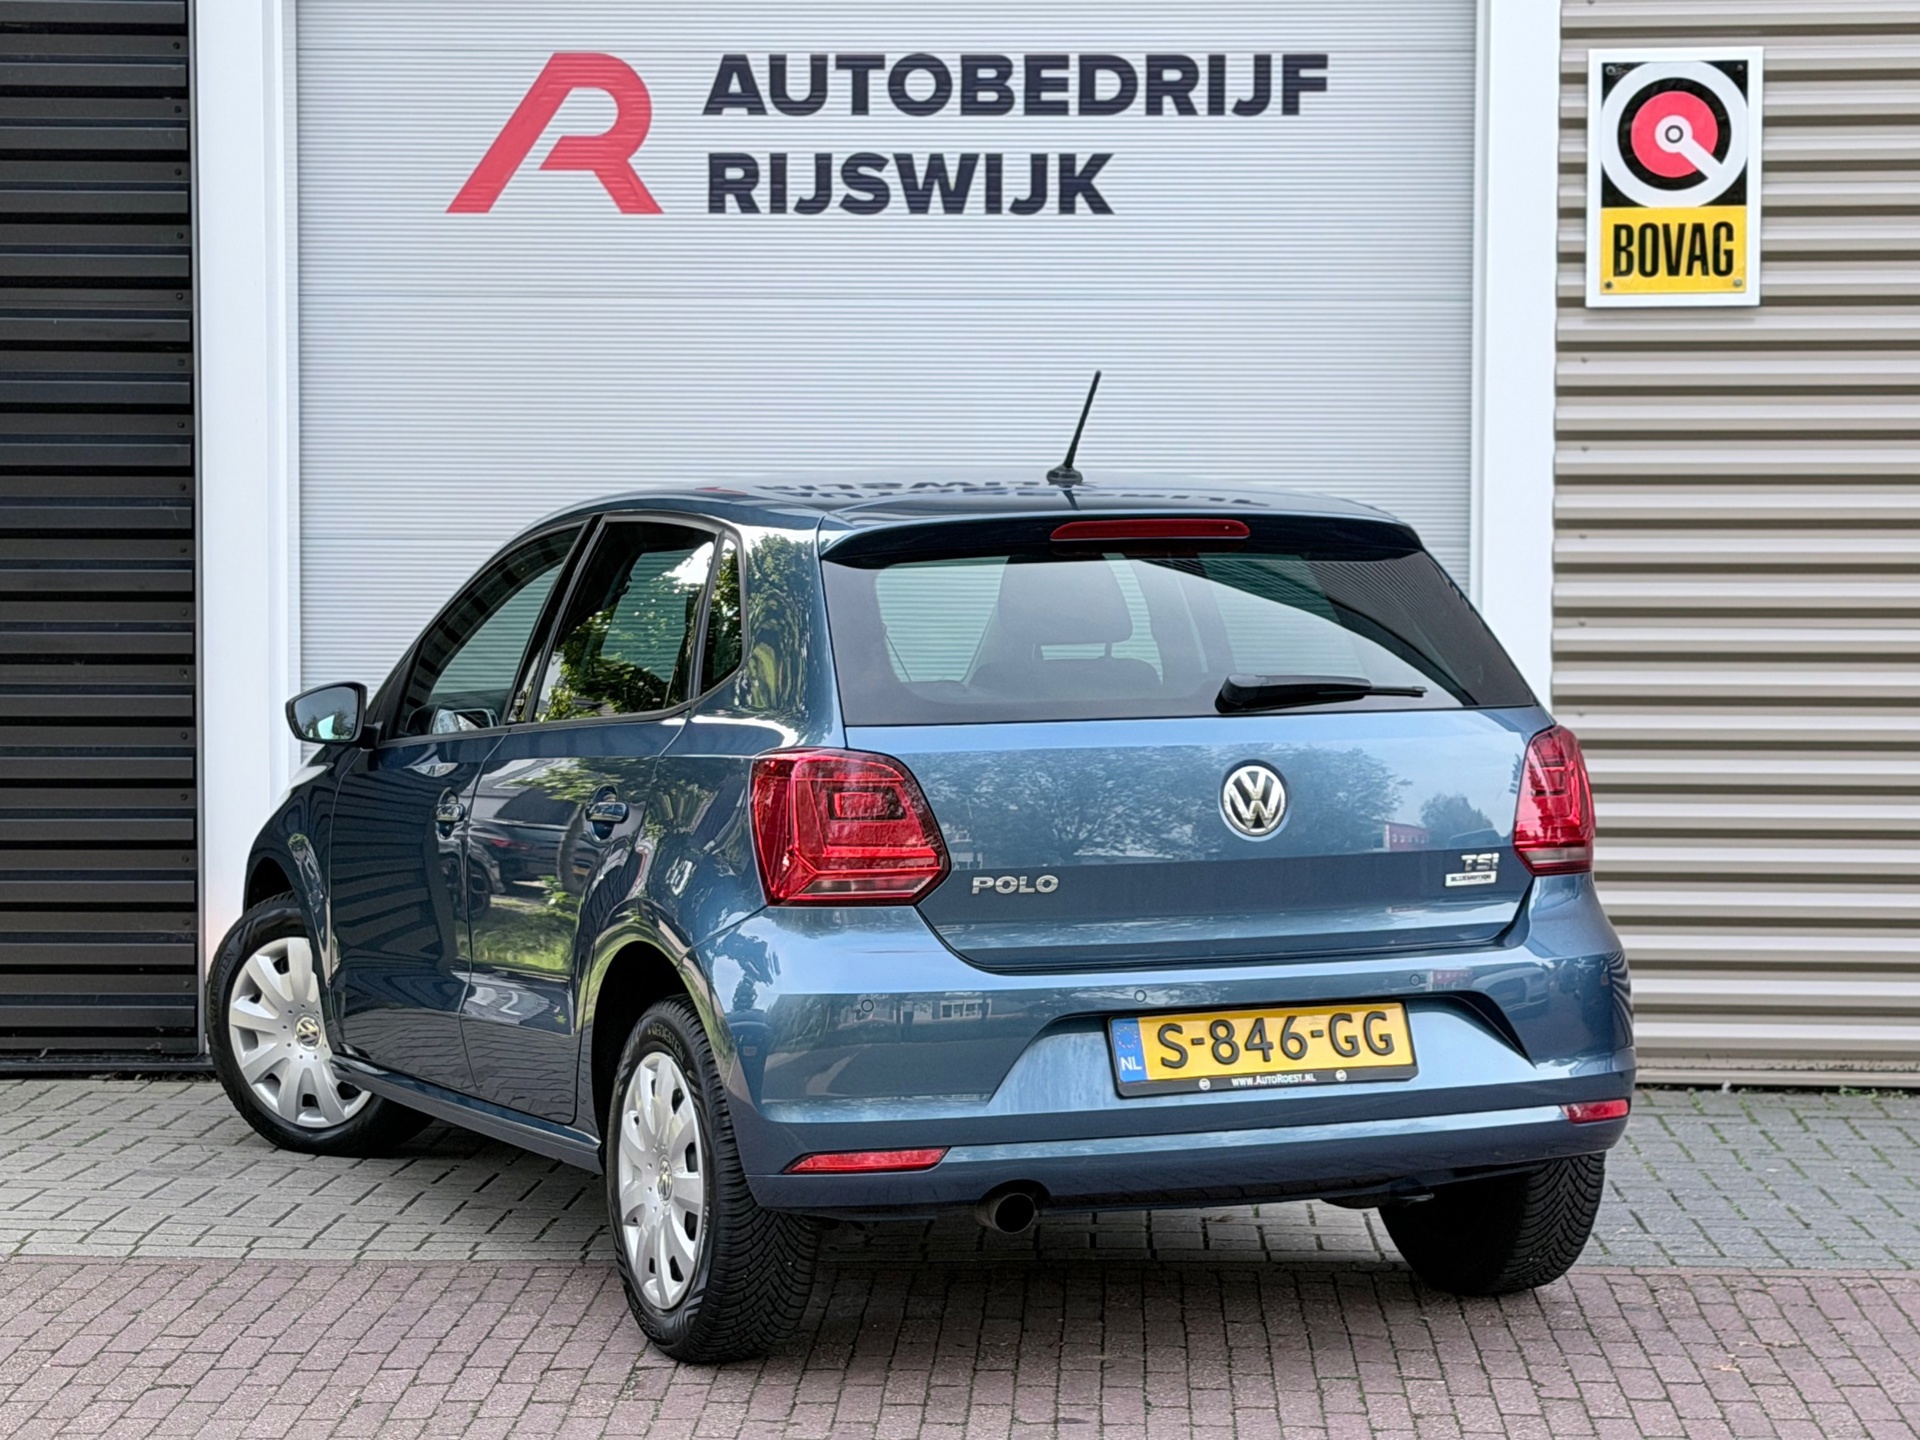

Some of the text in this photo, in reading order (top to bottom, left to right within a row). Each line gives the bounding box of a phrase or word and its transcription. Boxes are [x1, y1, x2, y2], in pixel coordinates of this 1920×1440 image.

[703, 53, 1329, 117] AUTOBEDRIJF
[707, 152, 1115, 214] RIJSWIJK
[1612, 221, 1735, 278] BOVAG
[971, 874, 1059, 895] POLO
[1120, 1056, 1142, 1071] NL
[1157, 1010, 1395, 1070] S-846-GG
